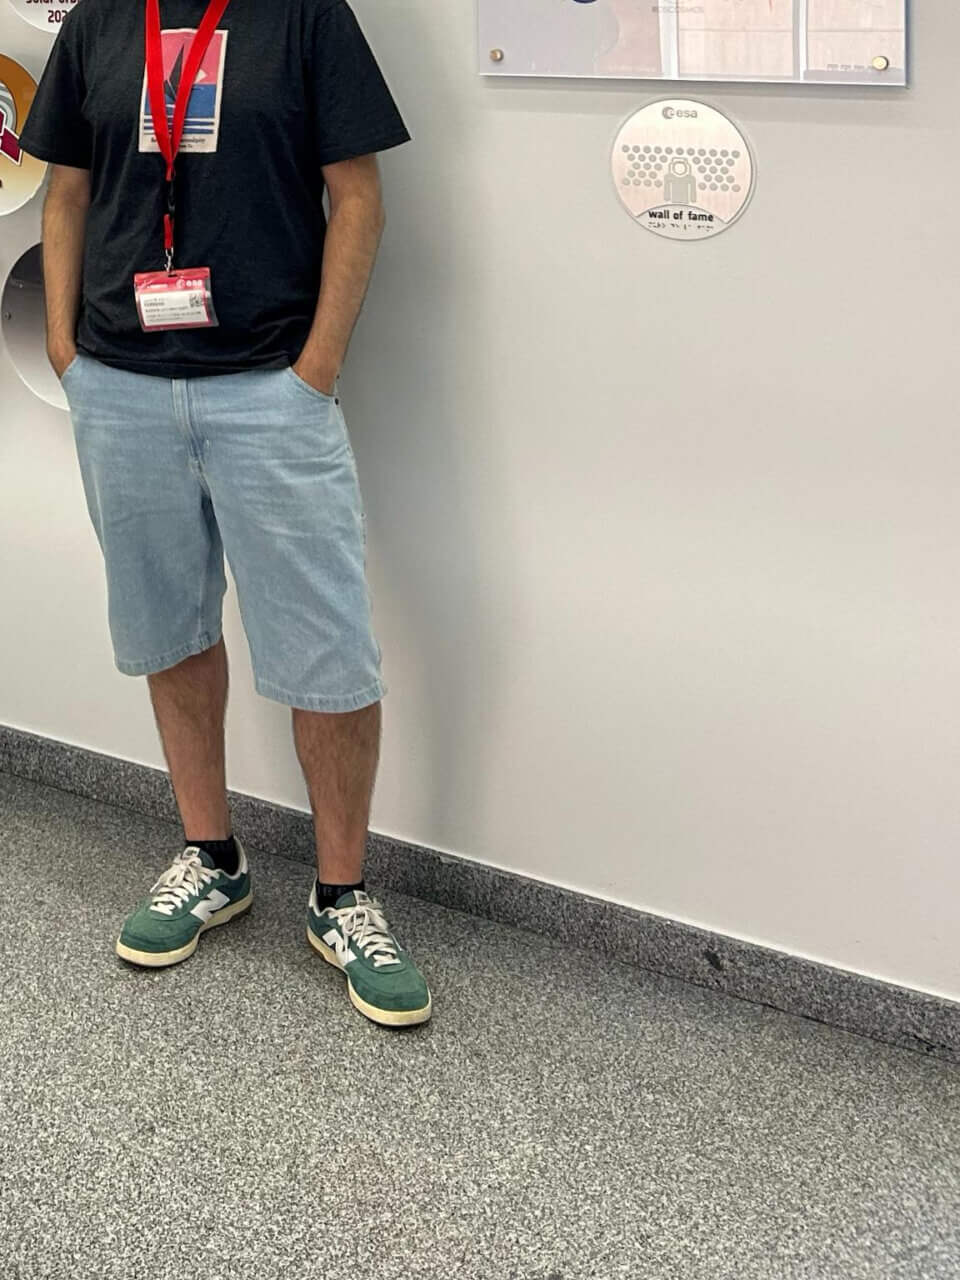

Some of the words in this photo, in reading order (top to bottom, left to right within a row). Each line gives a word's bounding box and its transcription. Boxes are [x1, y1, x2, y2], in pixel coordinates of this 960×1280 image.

[675, 108, 698, 119] esa
[648, 209, 670, 220] wall
[672, 210, 685, 220] of
[688, 211, 714, 222] fame
